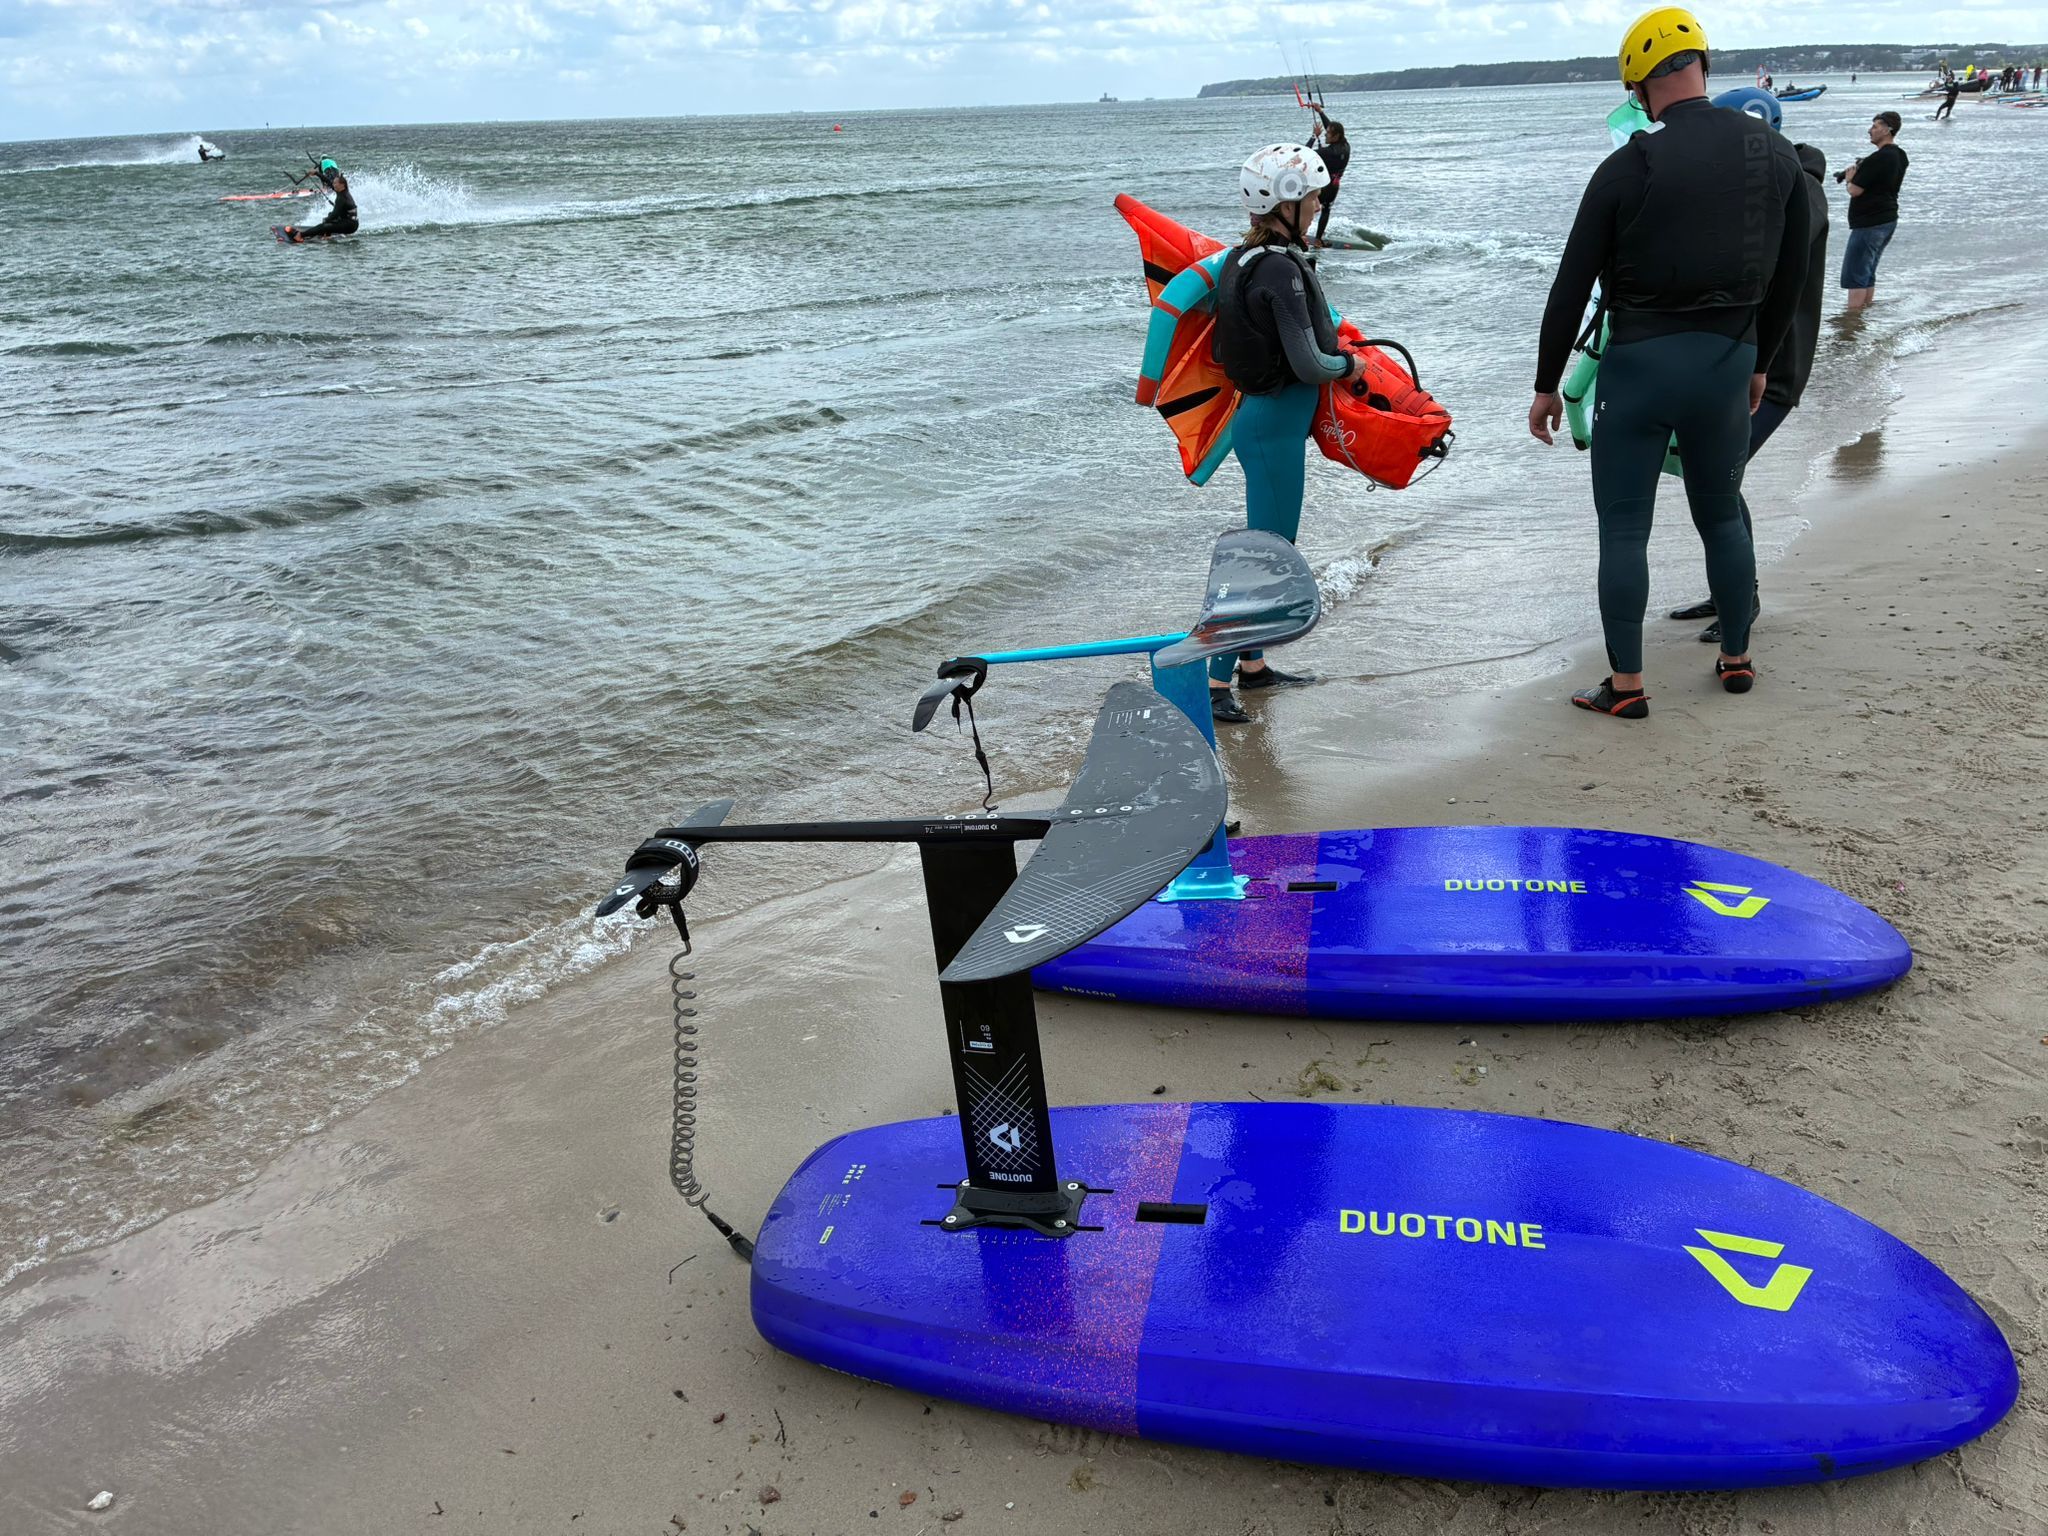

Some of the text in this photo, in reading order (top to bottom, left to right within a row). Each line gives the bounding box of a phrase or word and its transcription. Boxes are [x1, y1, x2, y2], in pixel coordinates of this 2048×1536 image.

[1444, 878, 1588, 894] DUOTONE
[1062, 985, 1117, 998] DUOTONE
[988, 1171, 1033, 1183] DUOTONE
[1338, 1208, 1547, 1250] DUOTONE
